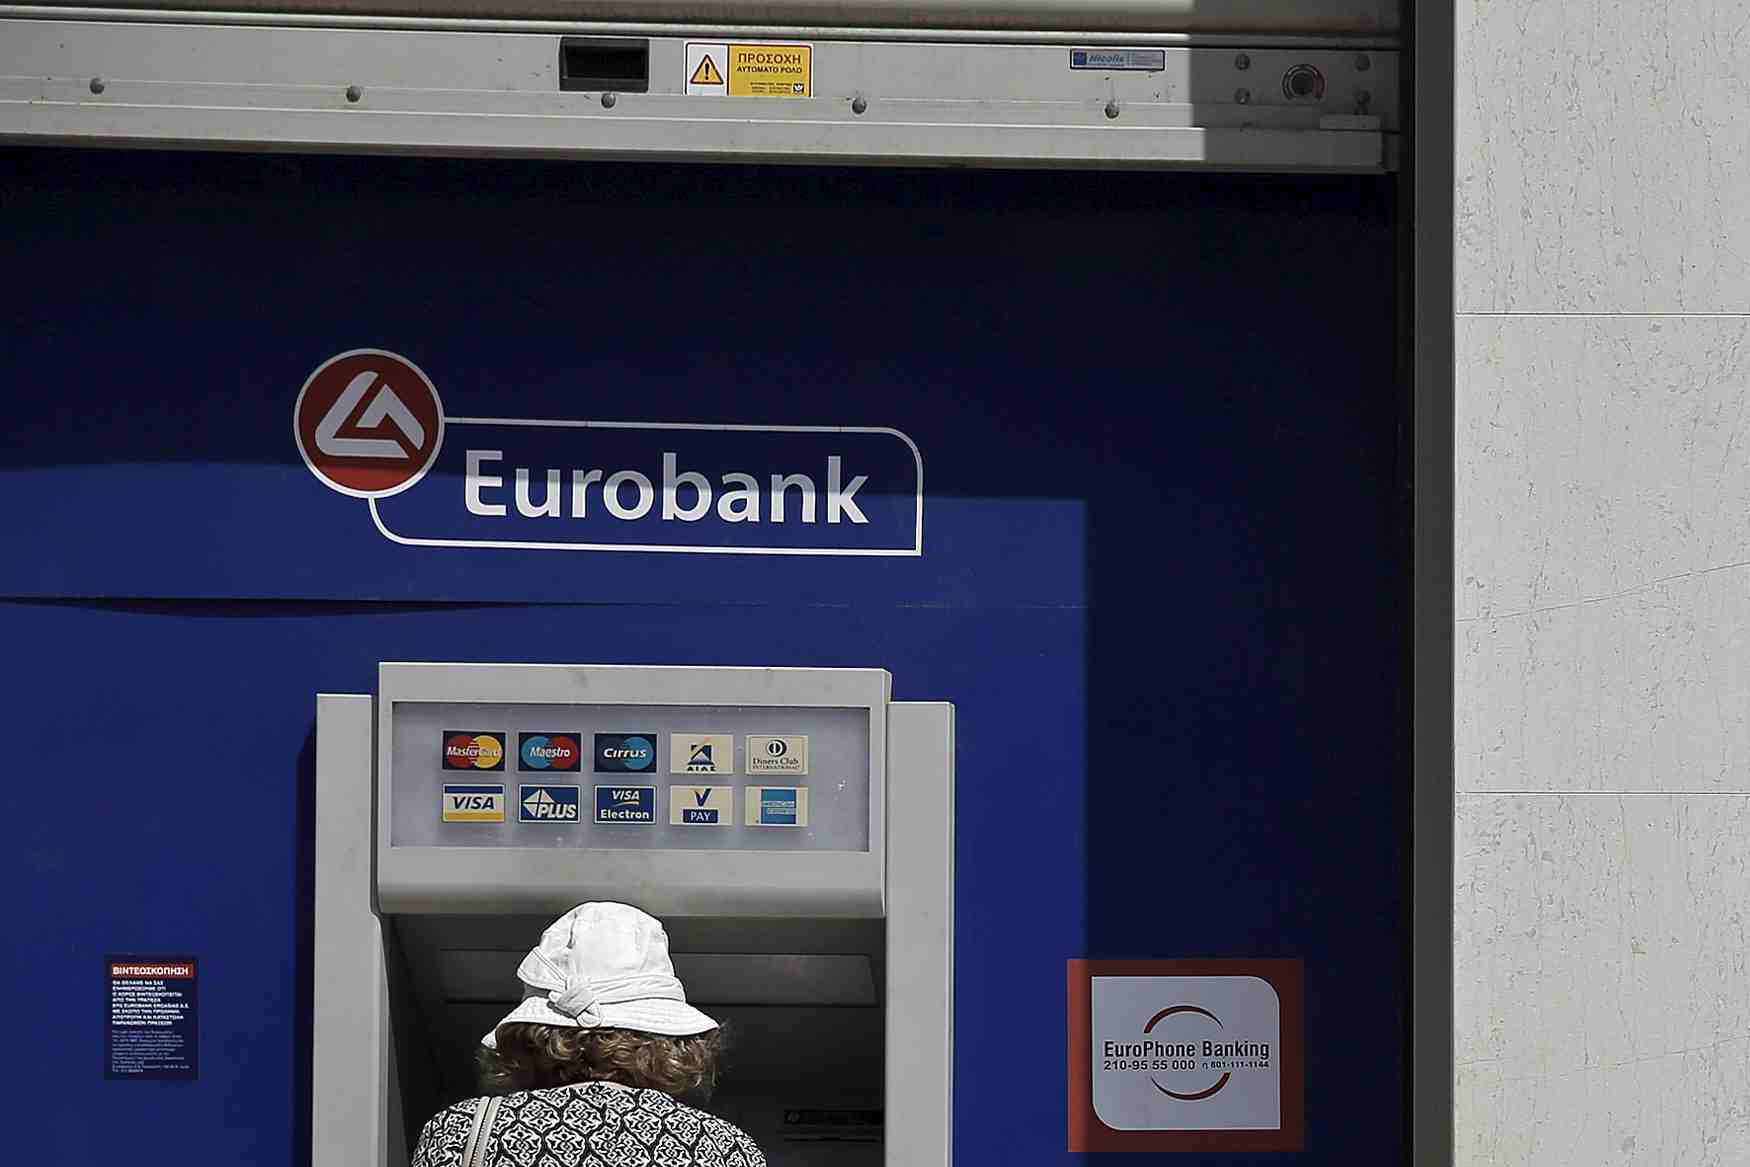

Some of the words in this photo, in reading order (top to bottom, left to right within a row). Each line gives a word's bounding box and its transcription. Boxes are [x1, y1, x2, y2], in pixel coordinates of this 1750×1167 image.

[737, 52, 801, 65] ΠΡΟΣΟΧΗ
[736, 65, 779, 73] ΑΥΤΟΜΑΤΟ
[462, 448, 870, 525] Eurobank
[446, 746, 501, 757] MasterCard
[529, 747, 571, 758] Maestro
[602, 748, 647, 759] Cirrus
[611, 790, 640, 800] VISA
[452, 796, 496, 810] VISA
[536, 804, 577, 819] PLUS
[600, 808, 650, 820] Electron
[690, 811, 711, 821] PAY
[1104, 1040, 1196, 1058] EuroPhone
[1202, 1040, 1270, 1059] Banking
[1103, 1059, 1149, 1071] 210-95
[1151, 1060, 1168, 1071] 55
[1173, 1060, 1196, 1071] 000
